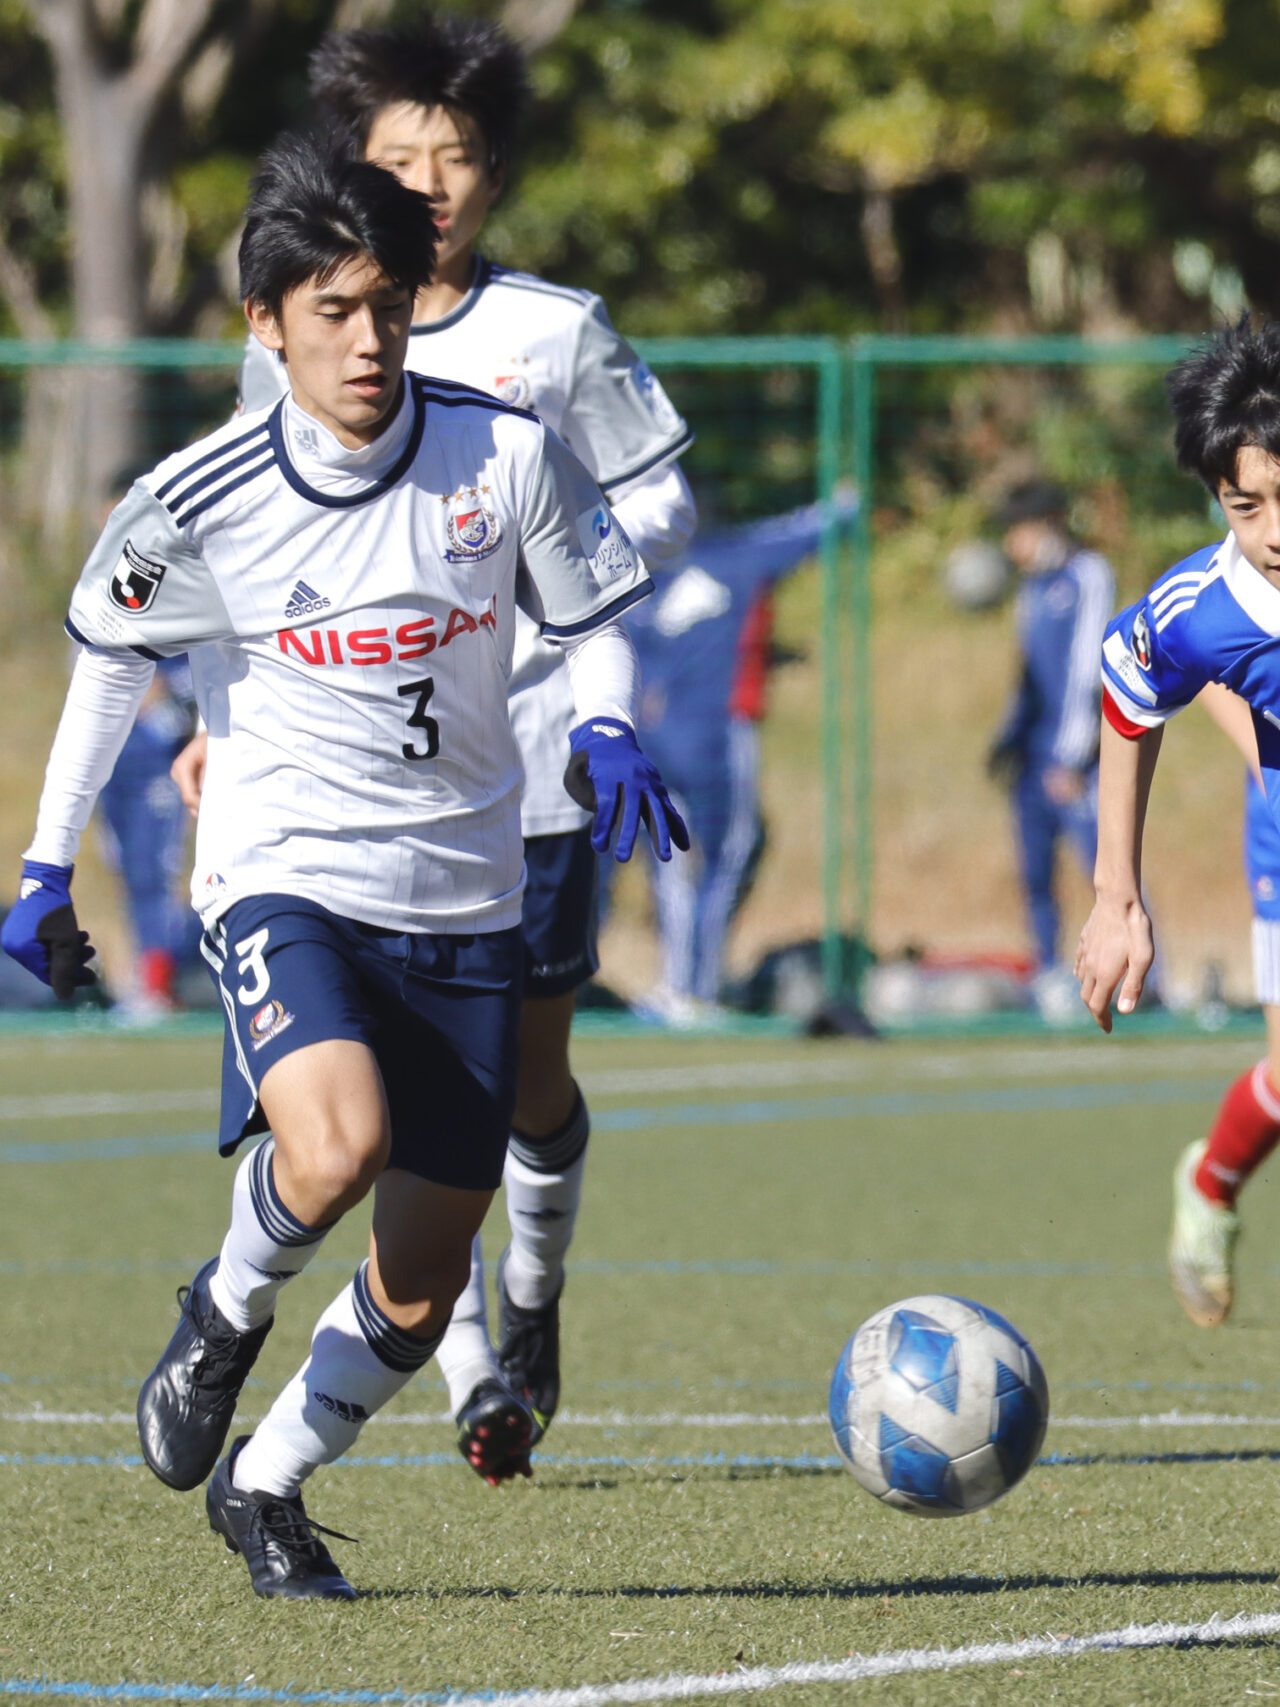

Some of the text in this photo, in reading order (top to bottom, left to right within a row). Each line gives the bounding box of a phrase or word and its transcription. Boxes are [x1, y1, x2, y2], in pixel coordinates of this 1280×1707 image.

[284, 596, 332, 619] adidas
[397, 676, 440, 761] 3
[234, 927, 271, 1006] 3
